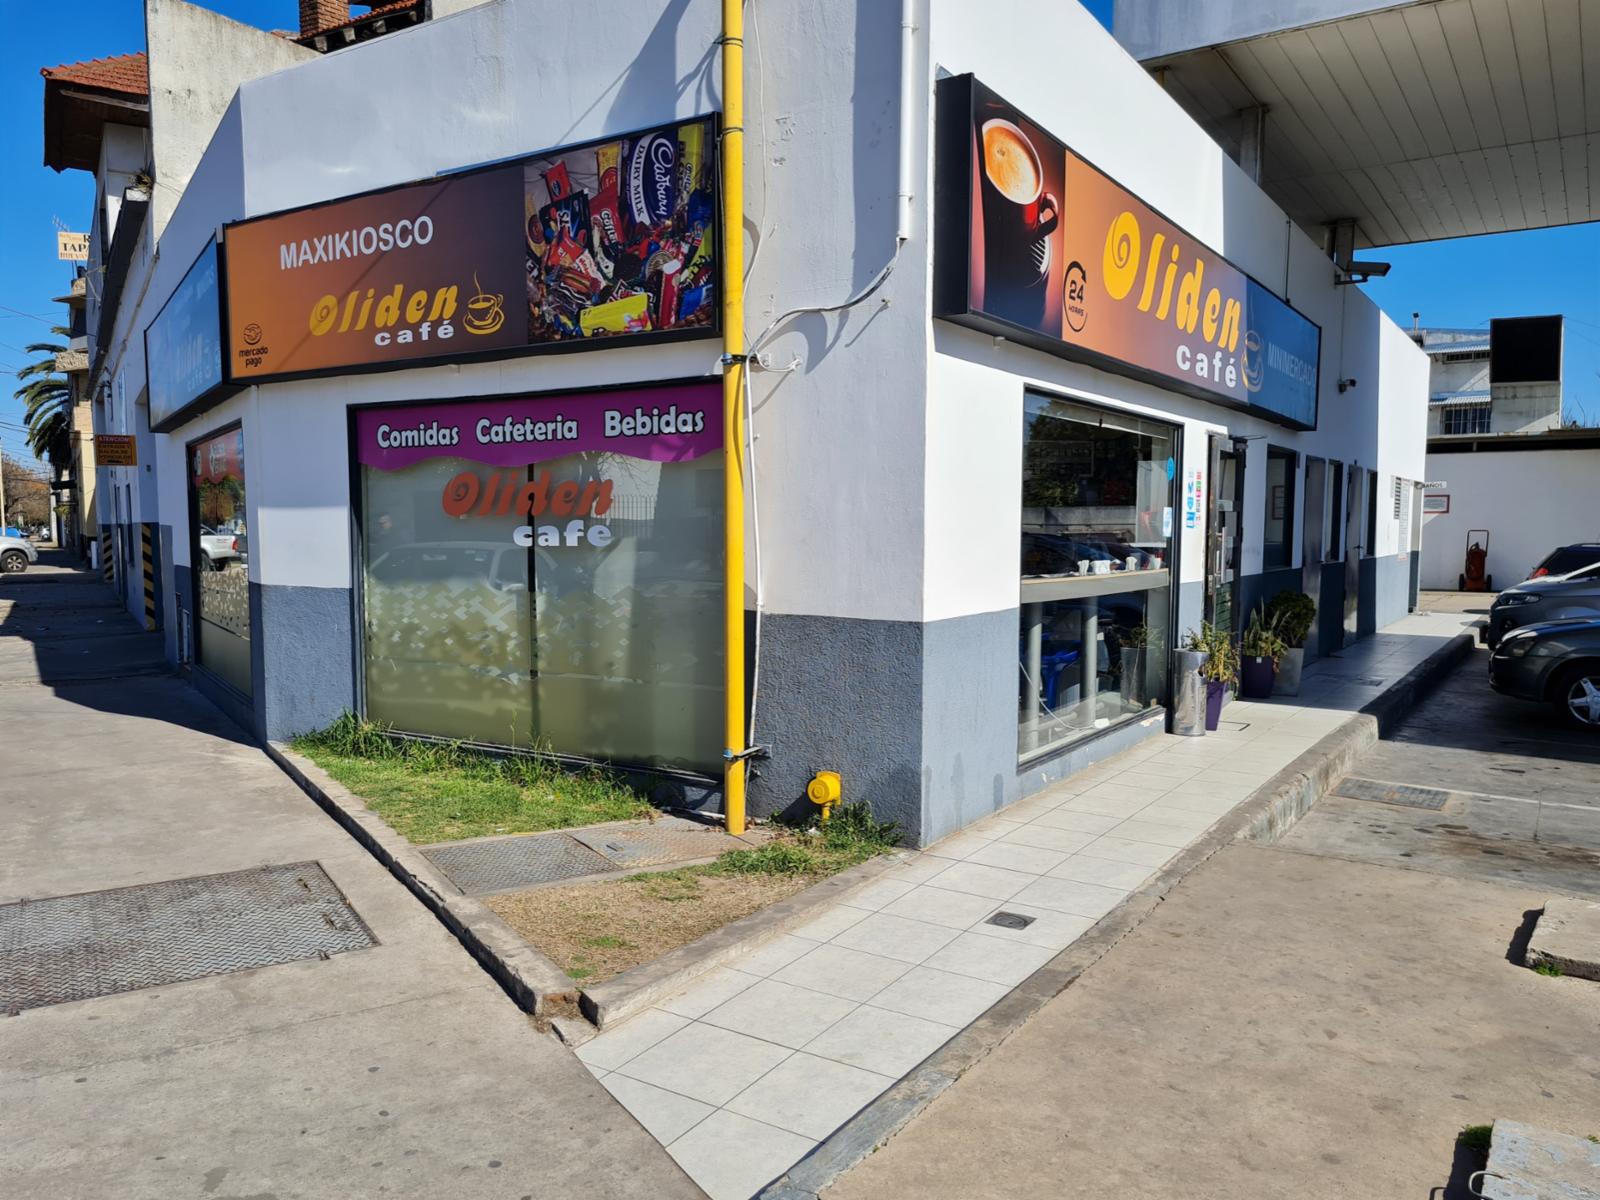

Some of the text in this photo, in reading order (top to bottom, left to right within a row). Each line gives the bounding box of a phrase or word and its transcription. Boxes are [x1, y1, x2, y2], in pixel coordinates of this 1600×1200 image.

[632, 145, 646, 214] DAIRY MILK
[651, 138, 675, 216] Cadbury
[280, 215, 433, 271] MAXIKIOSCO
[1068, 279, 1084, 304] 24
[1103, 211, 1241, 353] Oliden
[309, 284, 459, 337] Oliden
[239, 346, 269, 358] mercado
[374, 321, 455, 347] café
[245, 356, 263, 369] pago
[1176, 344, 1237, 388] café
[377, 405, 705, 448] Comidas Cafeteria Bebidas
[442, 471, 614, 518] Oliden
